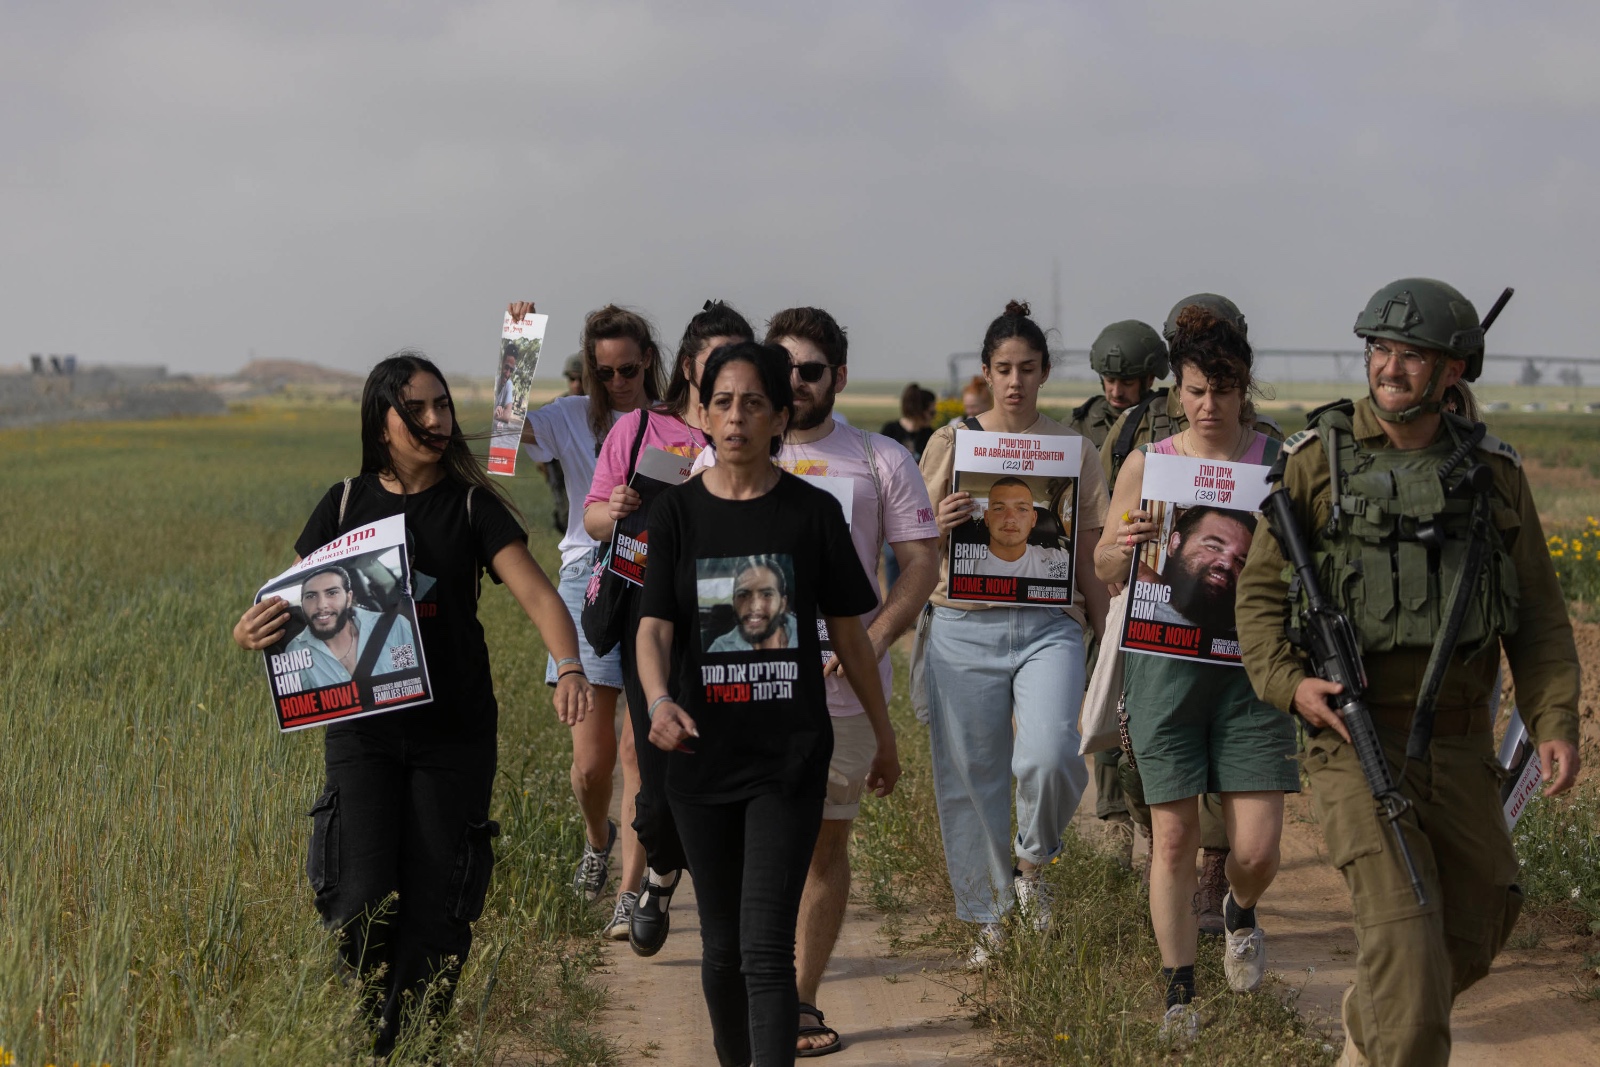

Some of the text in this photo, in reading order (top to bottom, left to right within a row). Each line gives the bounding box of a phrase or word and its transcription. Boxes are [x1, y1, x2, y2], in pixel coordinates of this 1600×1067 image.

[974, 446, 1064, 461] BAR ABRAHAM KUPERSHTEIN
[1033, 440, 1041, 450] בר
[1002, 460, 1021, 471] (22)
[1199, 464, 1233, 479] איתן הורן
[1194, 476, 1235, 491] EITAN HORN
[1195, 490, 1216, 502] (38)
[346, 527, 376, 546] מתן
[617, 533, 648, 556] BRING
[346, 545, 360, 555] מתן
[615, 544, 635, 562] HIM
[955, 543, 988, 560] BRING
[614, 556, 642, 579] HOME
[953, 559, 975, 575] HIM
[953, 576, 1017, 595] HOME NOW!
[1028, 590, 1049, 599] FAMILIES
[1134, 581, 1172, 603] BRING
[1131, 600, 1155, 620] HIM
[1128, 621, 1200, 648] HOME NOW!
[1211, 644, 1234, 655] FAMILIES
[271, 648, 313, 674] BRING
[701, 661, 798, 686] מחזירים את מתן
[275, 672, 302, 696] HIM
[374, 684, 423, 702] FAMILIES FORUM
[706, 681, 792, 703] הביתה עכשיו!
[280, 681, 359, 719] HOME NOW!
[1510, 793, 1525, 818] מתן
